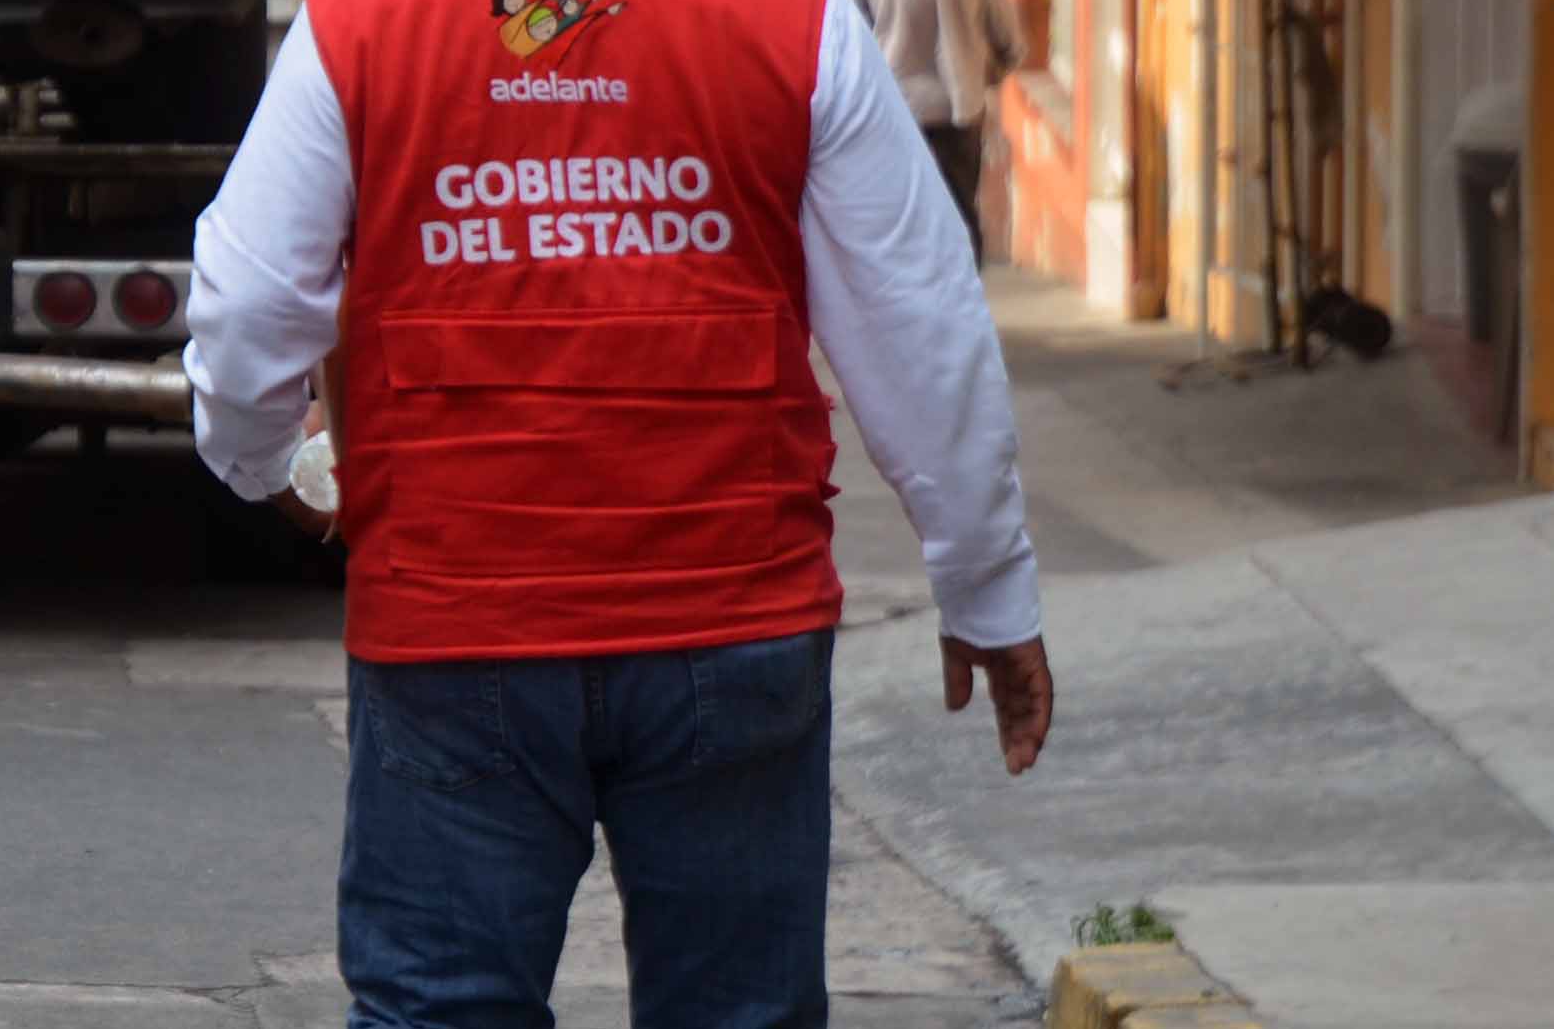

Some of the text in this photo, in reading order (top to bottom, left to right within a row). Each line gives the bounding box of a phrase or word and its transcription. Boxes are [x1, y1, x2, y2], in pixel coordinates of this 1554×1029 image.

[490, 71, 628, 103] adelante
[435, 156, 711, 209] GOBIERNO
[420, 211, 733, 265] DEL ESTADO
